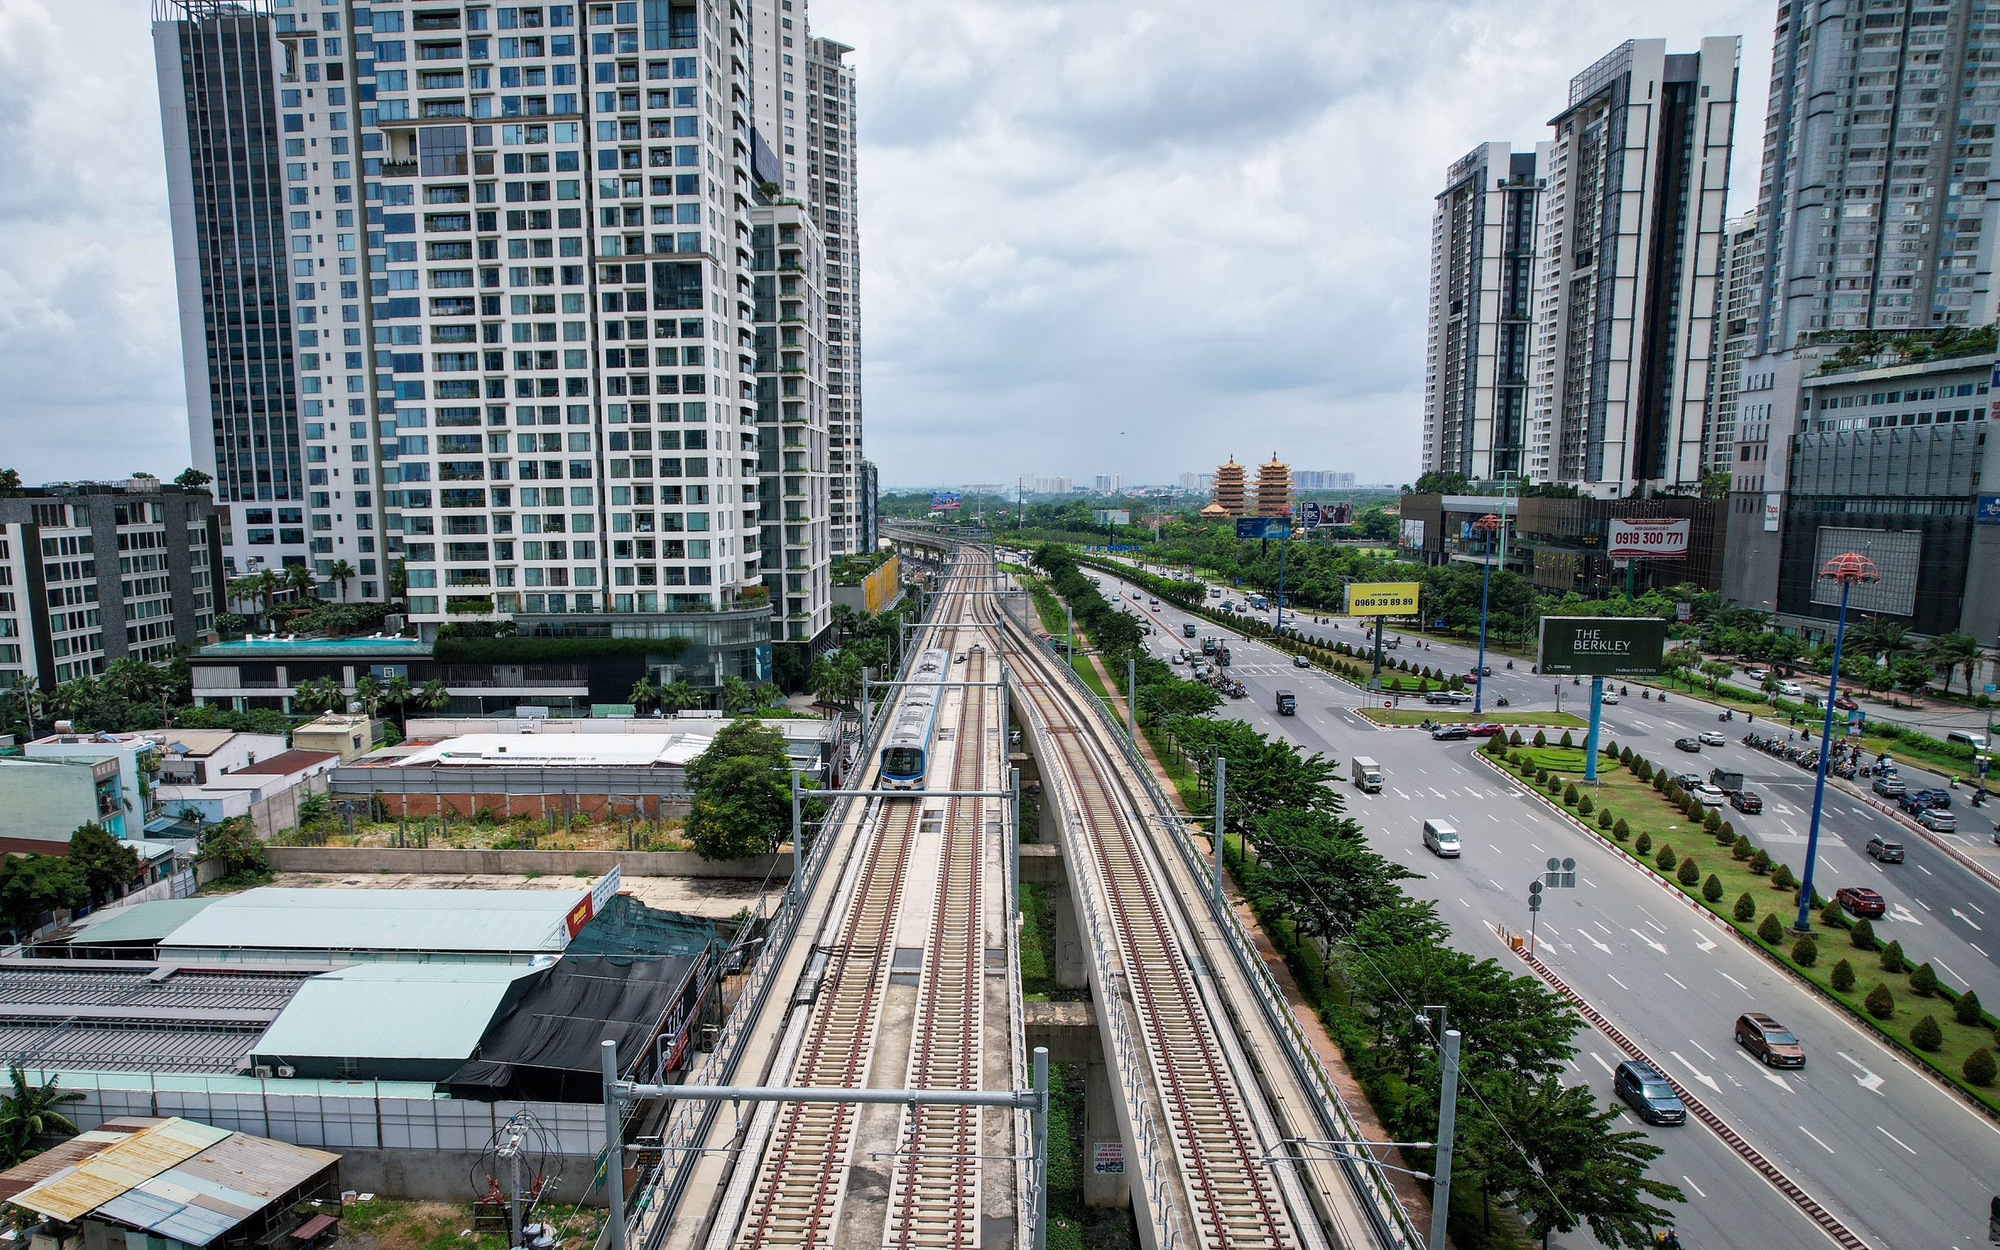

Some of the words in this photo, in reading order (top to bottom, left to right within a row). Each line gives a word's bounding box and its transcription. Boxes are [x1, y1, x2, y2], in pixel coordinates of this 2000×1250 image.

[1616, 532, 1640, 544] 0919
[1643, 532, 1663, 544] 300
[1667, 532, 1683, 544] 771
[1355, 598, 1413, 607] 0969.39.89.89
[1576, 629, 1600, 639] THE
[1574, 640, 1631, 650] BERKLEY
